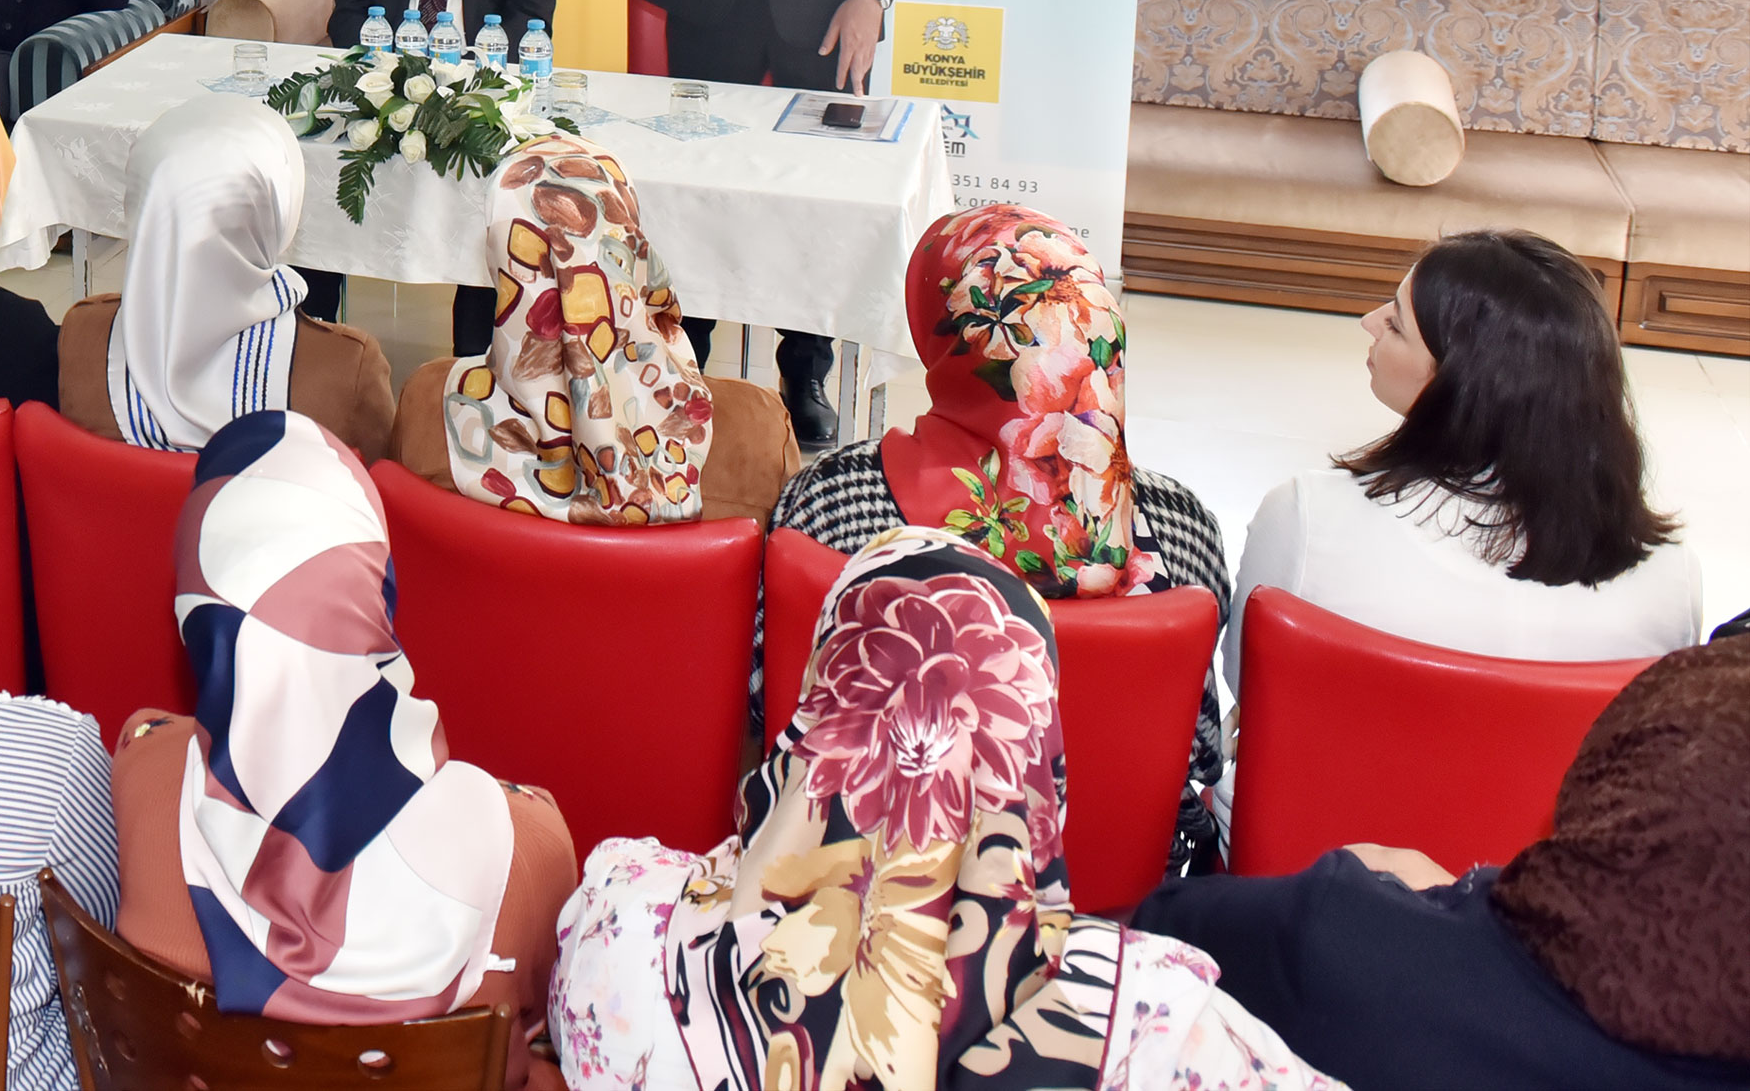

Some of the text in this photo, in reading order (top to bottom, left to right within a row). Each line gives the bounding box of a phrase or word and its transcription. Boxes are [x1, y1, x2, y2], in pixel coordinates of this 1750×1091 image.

[925, 53, 965, 65] KONYA
[903, 62, 986, 80] BÜYÜKŞEHİR
[919, 77, 969, 87] BELEDİYESİ
[952, 174, 1038, 193] 351 84 93
